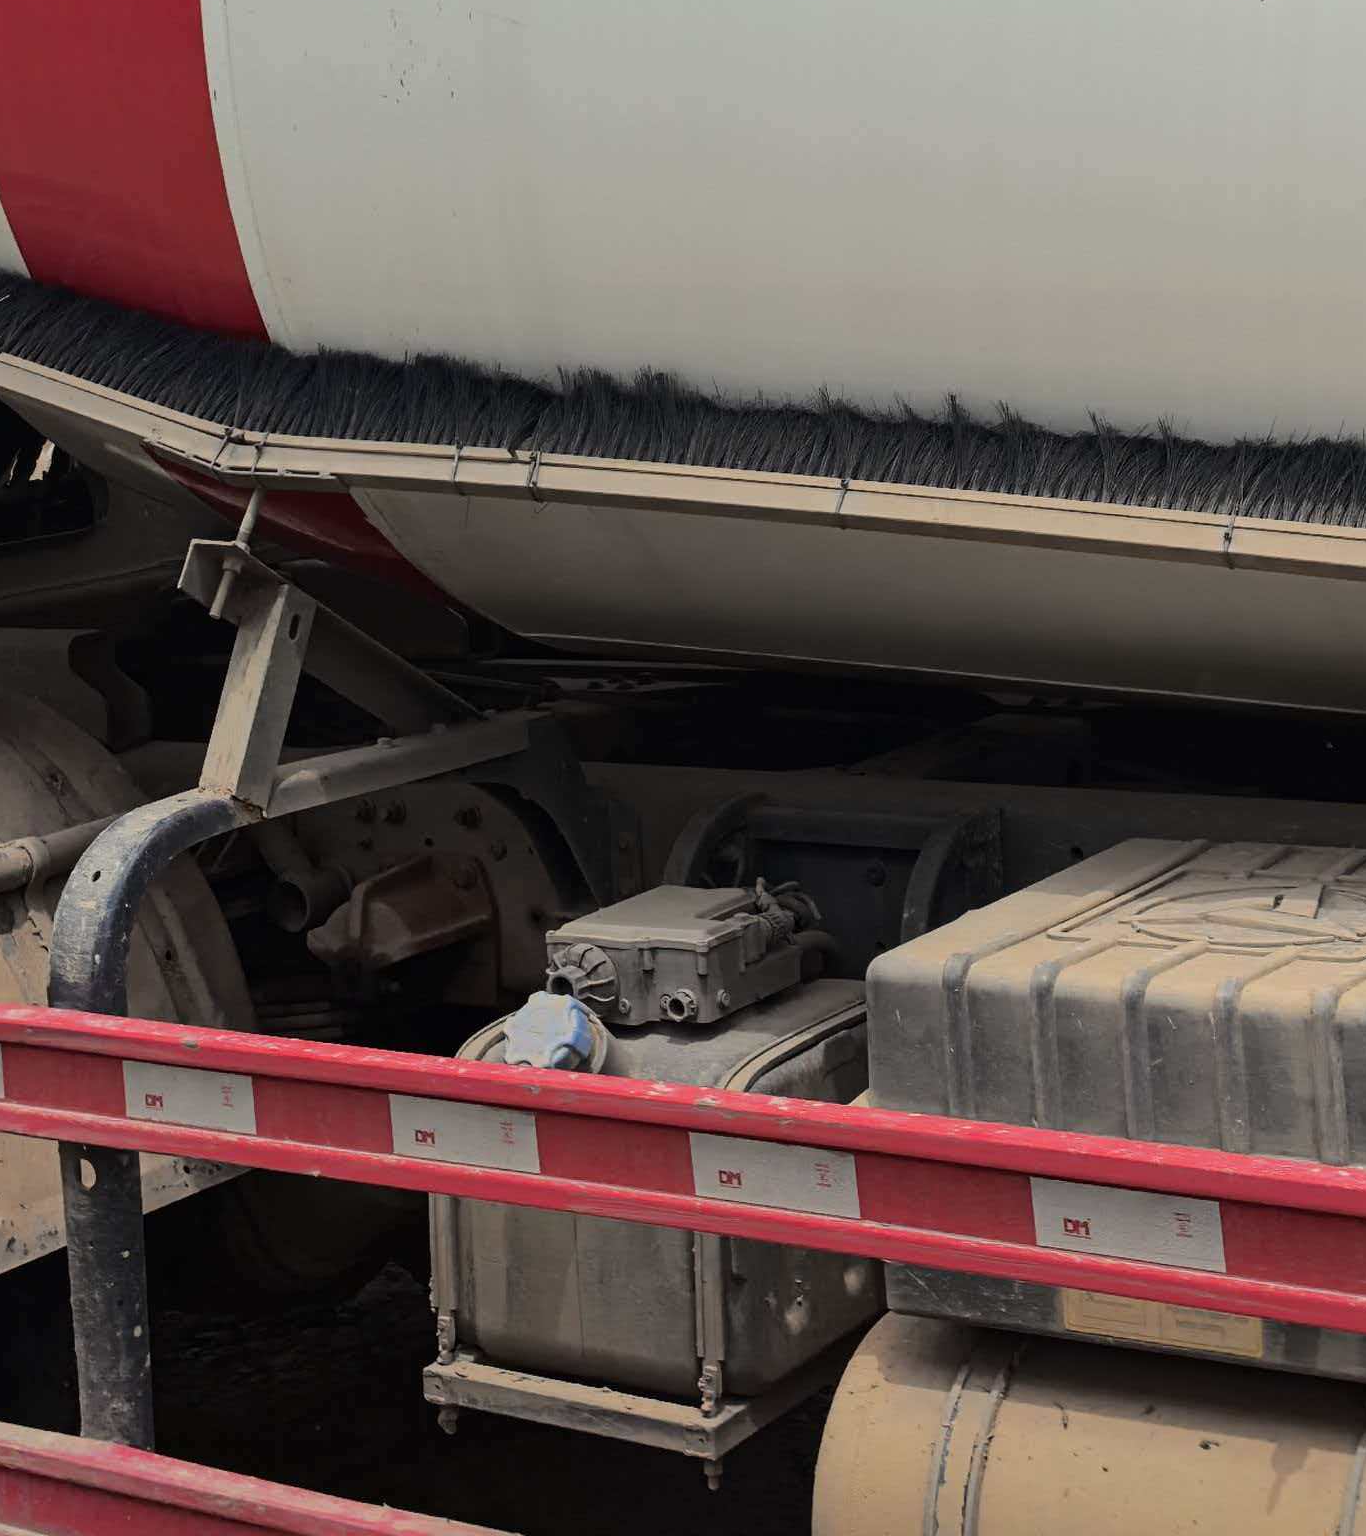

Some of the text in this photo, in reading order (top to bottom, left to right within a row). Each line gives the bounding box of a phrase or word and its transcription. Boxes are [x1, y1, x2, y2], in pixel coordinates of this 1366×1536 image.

[145, 1093, 163, 1108] DM
[415, 1129, 435, 1144] DM
[718, 1170, 742, 1186] DM
[1063, 1217, 1090, 1236] DM
